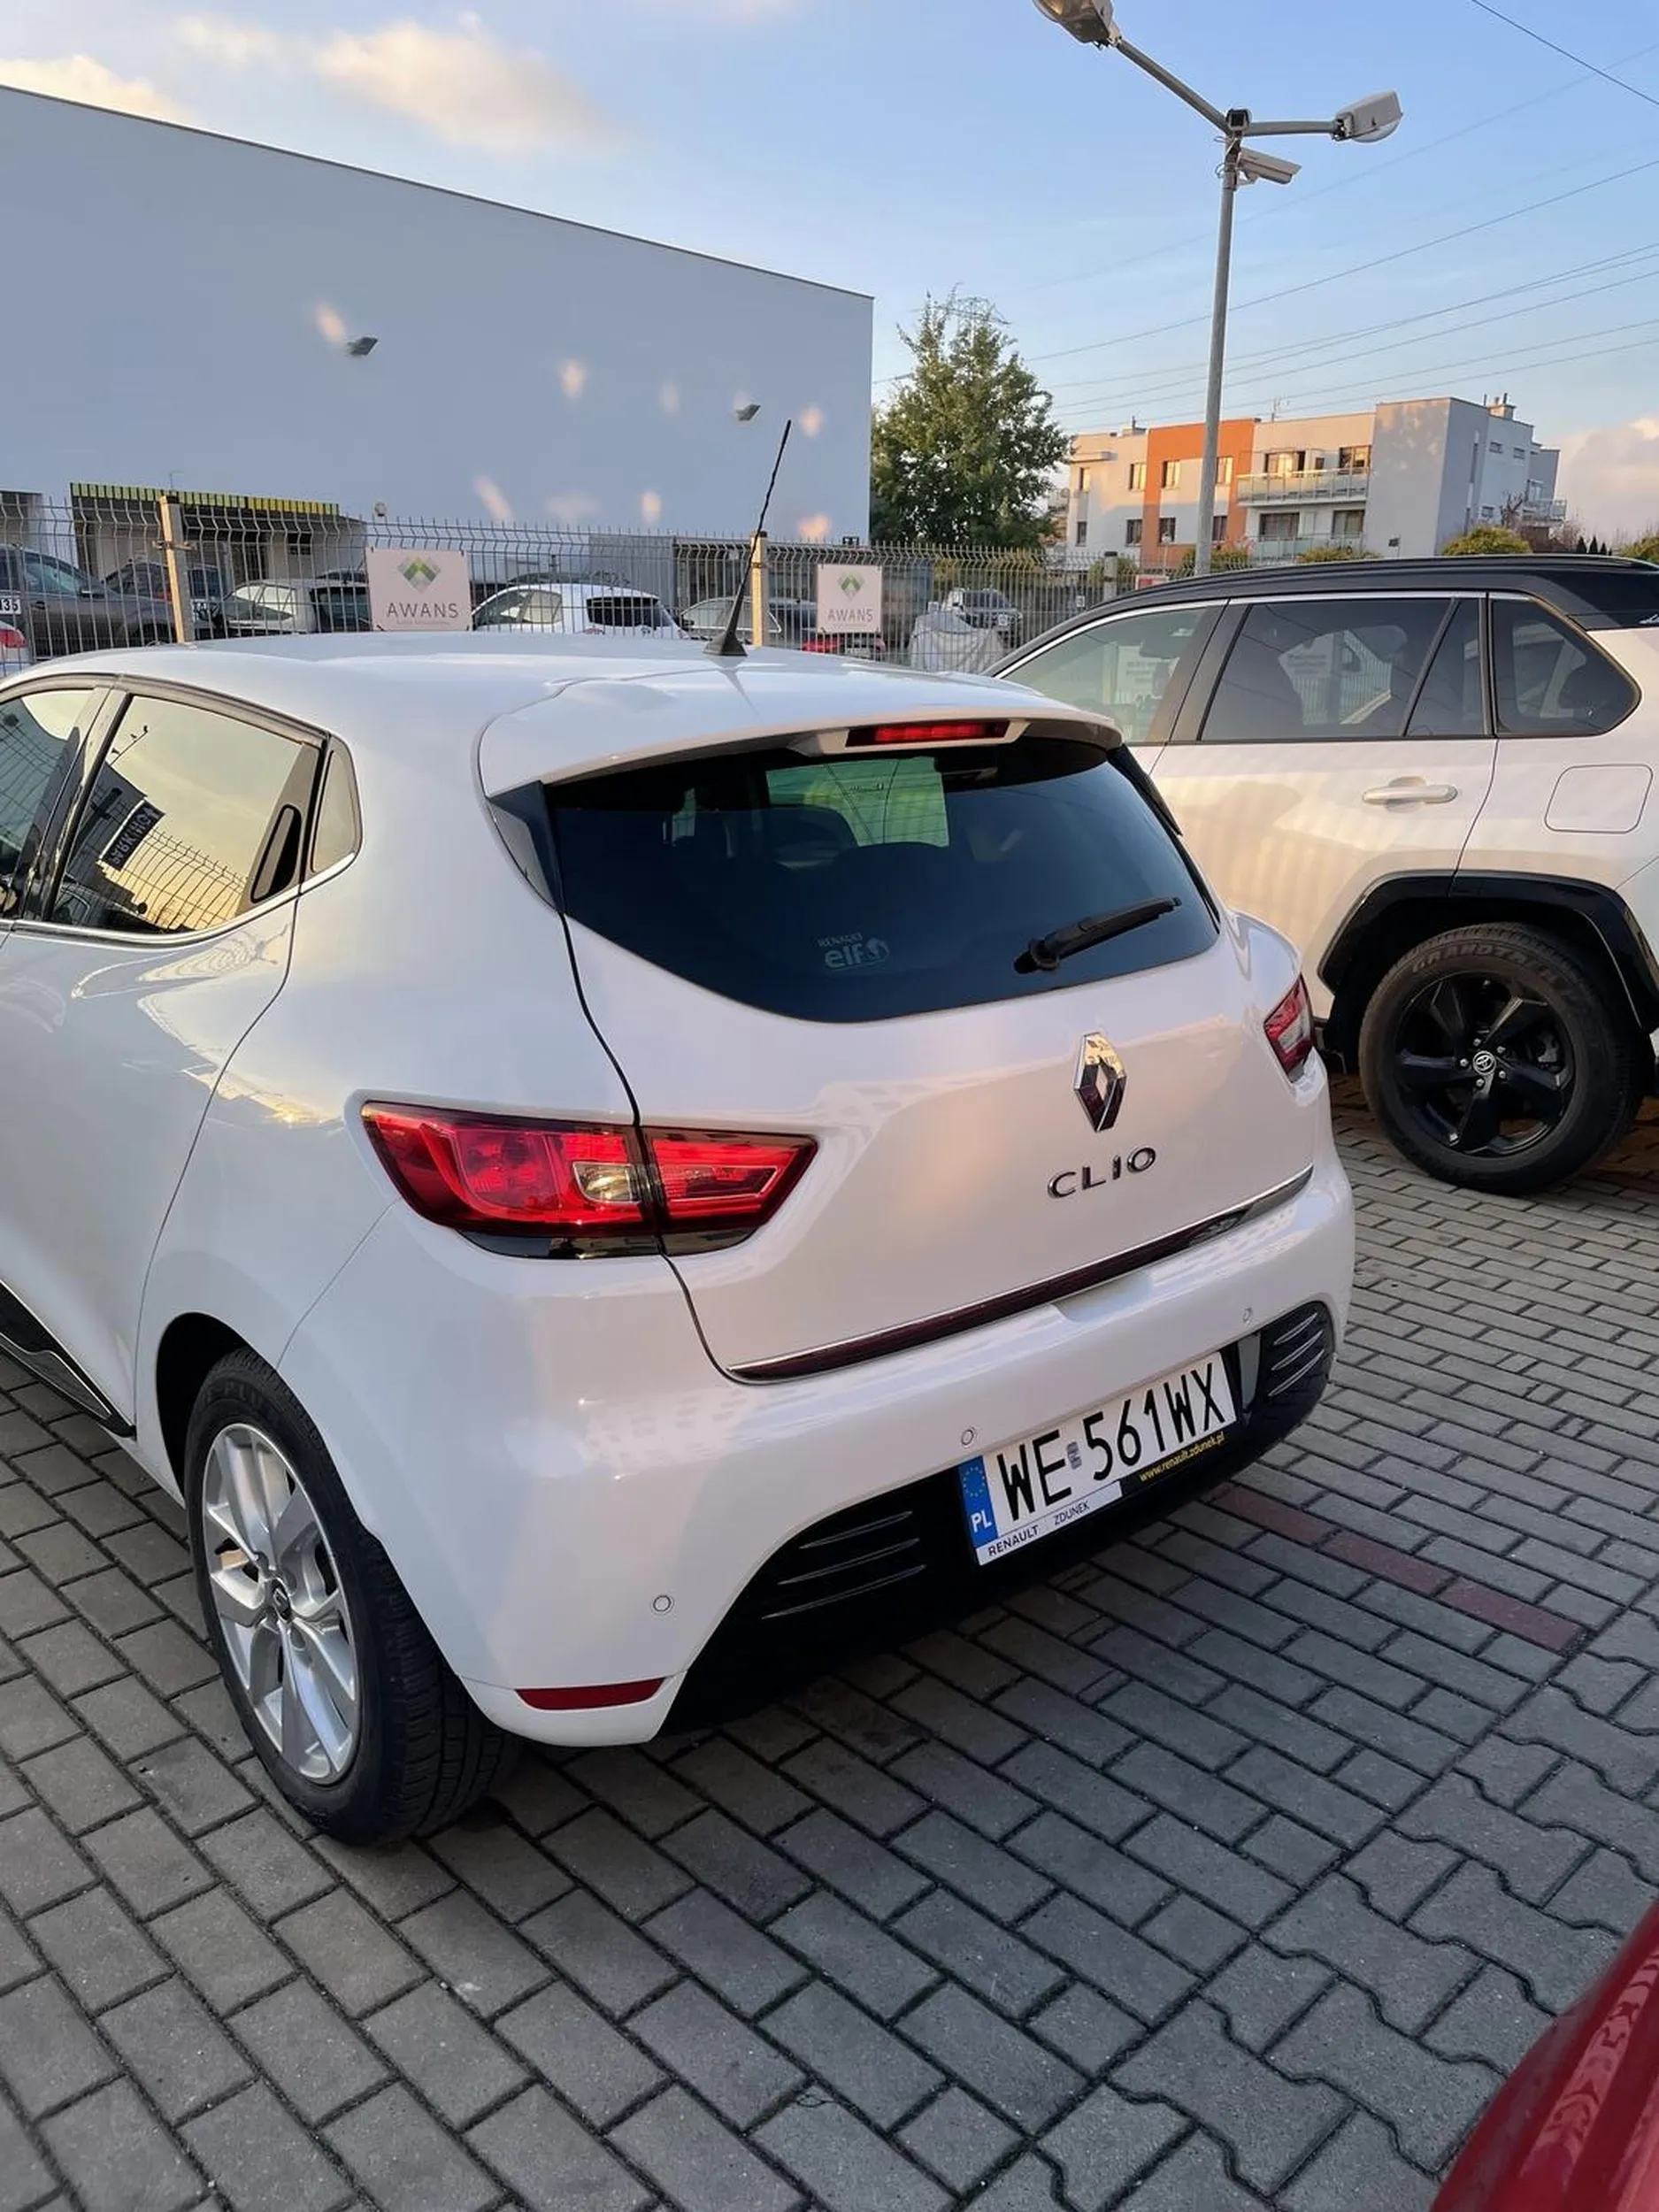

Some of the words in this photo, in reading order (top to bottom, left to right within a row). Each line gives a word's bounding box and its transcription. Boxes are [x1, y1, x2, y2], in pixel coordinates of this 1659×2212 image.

[0, 598, 19, 611] 35
[387, 602, 459, 618] AWANS
[827, 608, 873, 622] AWANS
[1047, 1147, 1156, 1199] CLIO
[996, 1430, 1072, 1522] WE
[1082, 1363, 1225, 1481] 561WX
[971, 1509, 992, 1533] PL
[987, 1525, 1040, 1557] RENAULT
[1053, 1501, 1091, 1526] ZDUNEK
